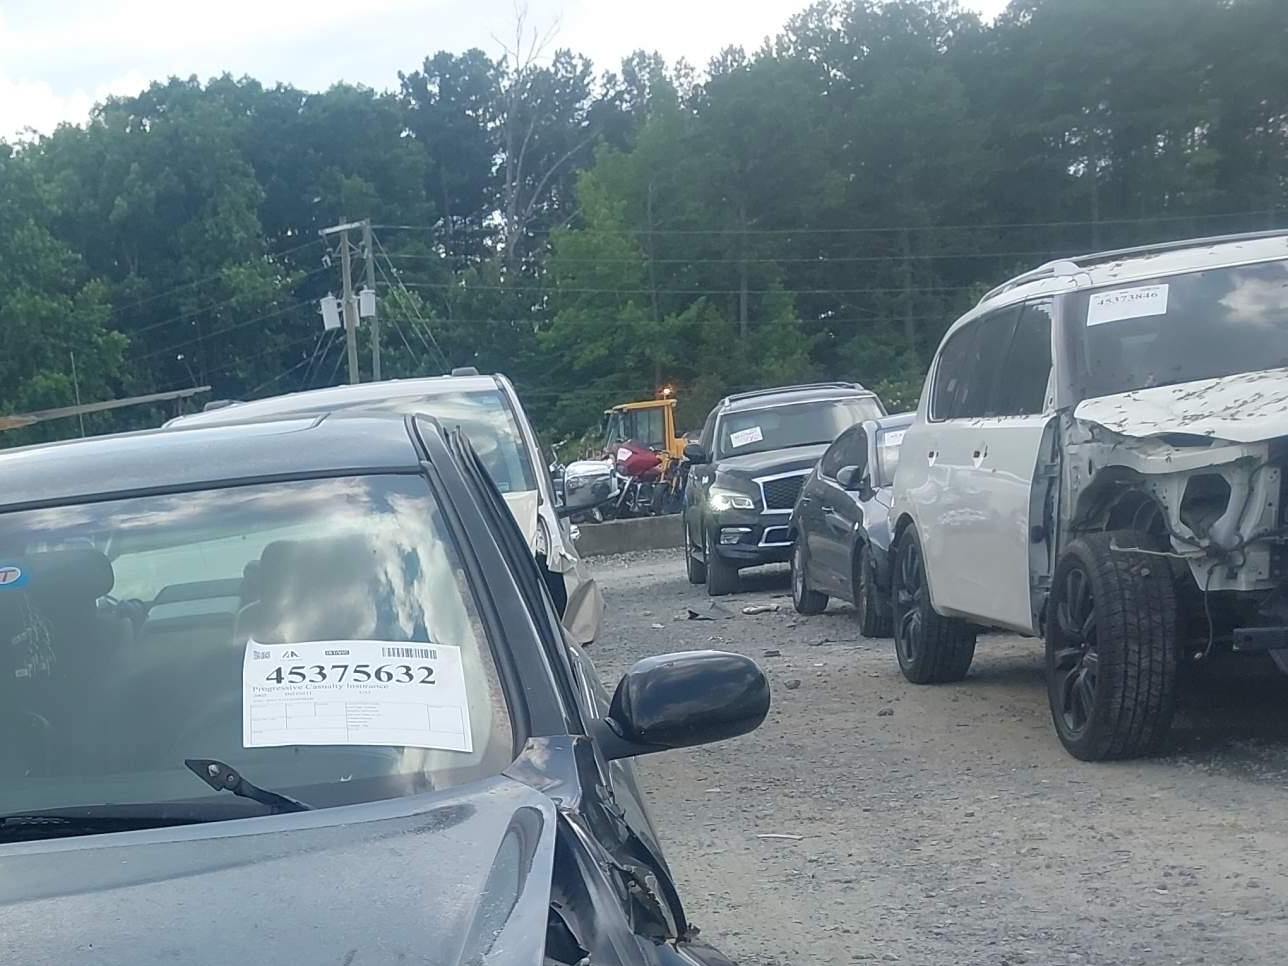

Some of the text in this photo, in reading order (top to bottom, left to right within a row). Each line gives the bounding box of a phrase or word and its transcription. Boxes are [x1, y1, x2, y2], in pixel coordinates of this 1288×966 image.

[266, 664, 436, 684] 45375632
[252, 685, 305, 693] Progressive
[306, 683, 343, 691] Casualty
